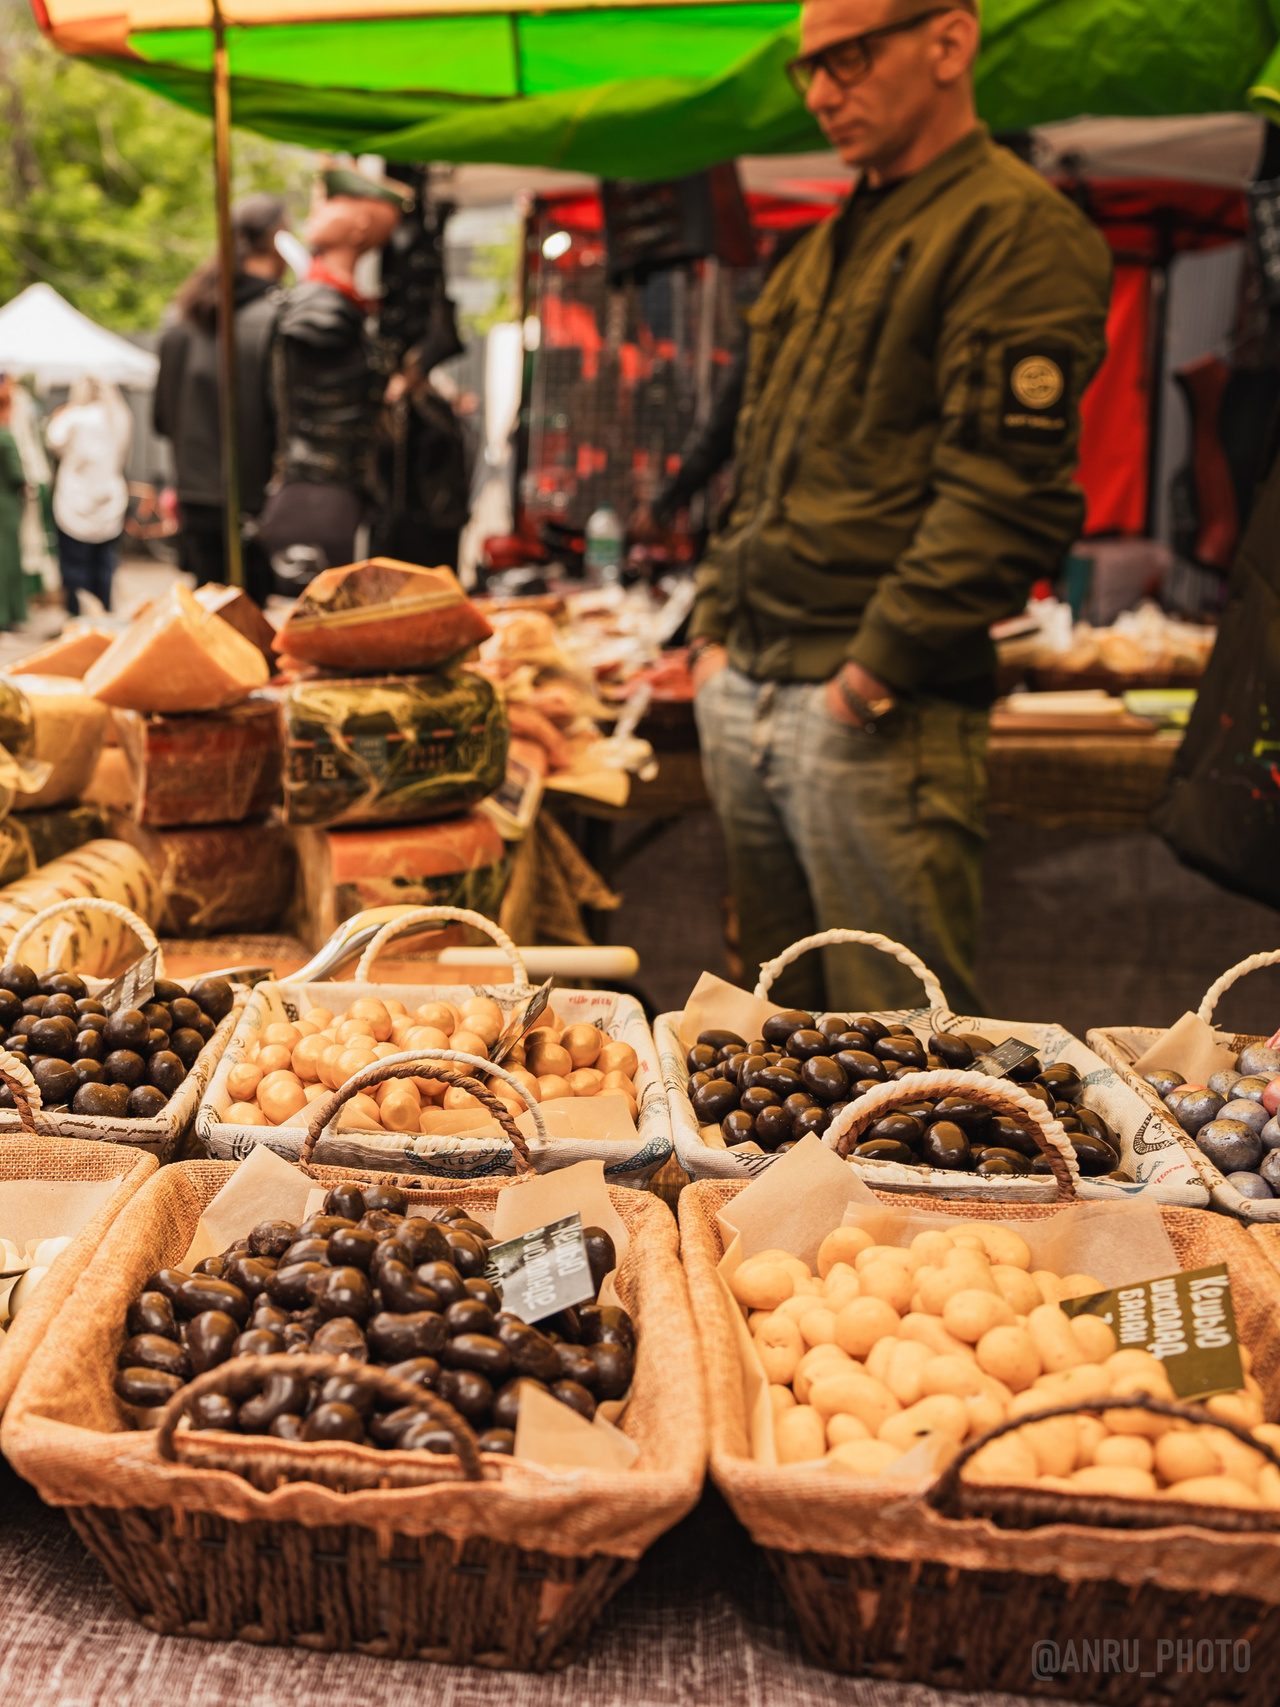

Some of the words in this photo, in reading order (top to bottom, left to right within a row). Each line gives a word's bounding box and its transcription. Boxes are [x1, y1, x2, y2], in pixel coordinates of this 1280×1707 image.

[549, 1221, 586, 1277] Кешью
[1117, 1287, 1149, 1344] БАНАН
[1188, 1274, 1232, 1349] Кешью
